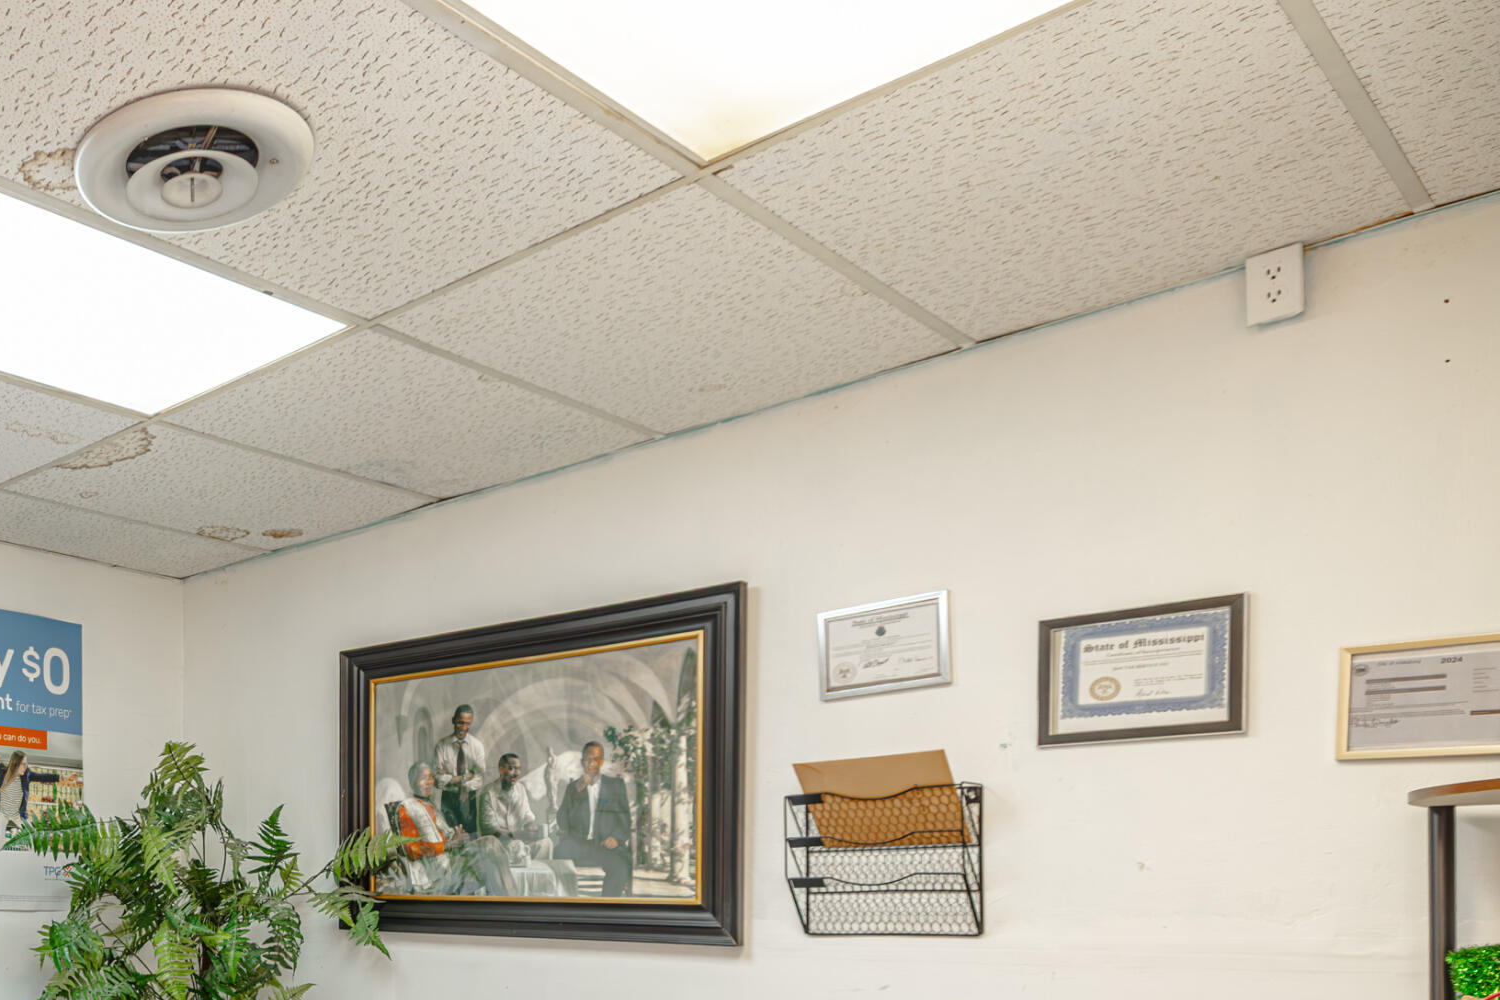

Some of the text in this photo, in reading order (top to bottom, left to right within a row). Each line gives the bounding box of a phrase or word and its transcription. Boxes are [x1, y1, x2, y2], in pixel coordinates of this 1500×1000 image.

[1083, 634, 1206, 654] State of Mississippi
[1440, 656, 1464, 664] 2024
[21, 646, 70, 695] $0
[15, 700, 29, 713] for
[32, 703, 47, 716] tax
[3, 733, 16, 742] can
[17, 733, 27, 743] do
